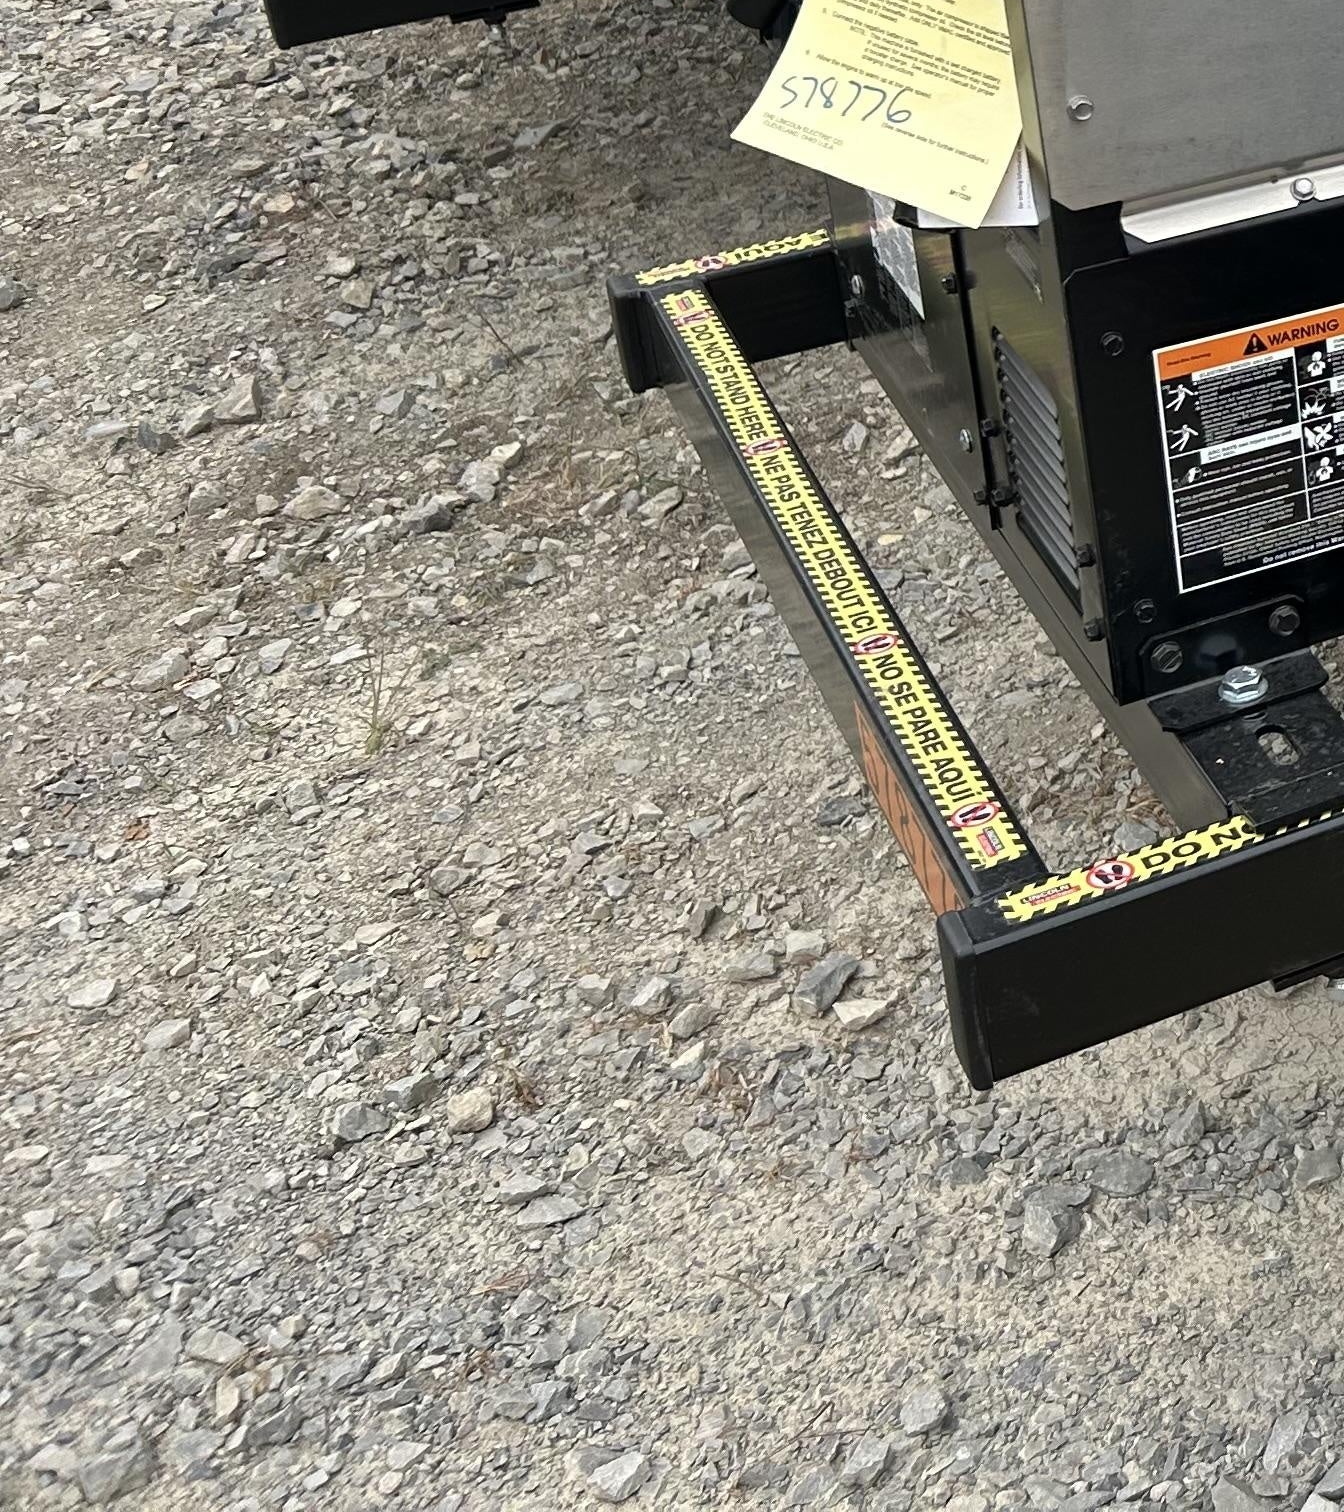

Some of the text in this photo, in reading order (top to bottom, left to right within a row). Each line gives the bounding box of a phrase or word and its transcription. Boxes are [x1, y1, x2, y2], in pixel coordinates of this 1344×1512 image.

[780, 76, 912, 123] 578776
[1267, 318, 1340, 347] WARNING
[691, 325, 768, 440] DO NOT STAND HERE
[760, 455, 878, 635] NE PAS TENEZ DEBOUT ICI
[1262, 555, 1273, 563] Do
[1274, 551, 1287, 560] not
[1287, 543, 1315, 556] remove
[1315, 539, 1329, 548] this
[873, 653, 904, 681] NO
[888, 681, 918, 706] SE
[903, 704, 948, 757] PARE
[1142, 842, 1202, 869] DO
[1021, 883, 1070, 903] LINCOLN
